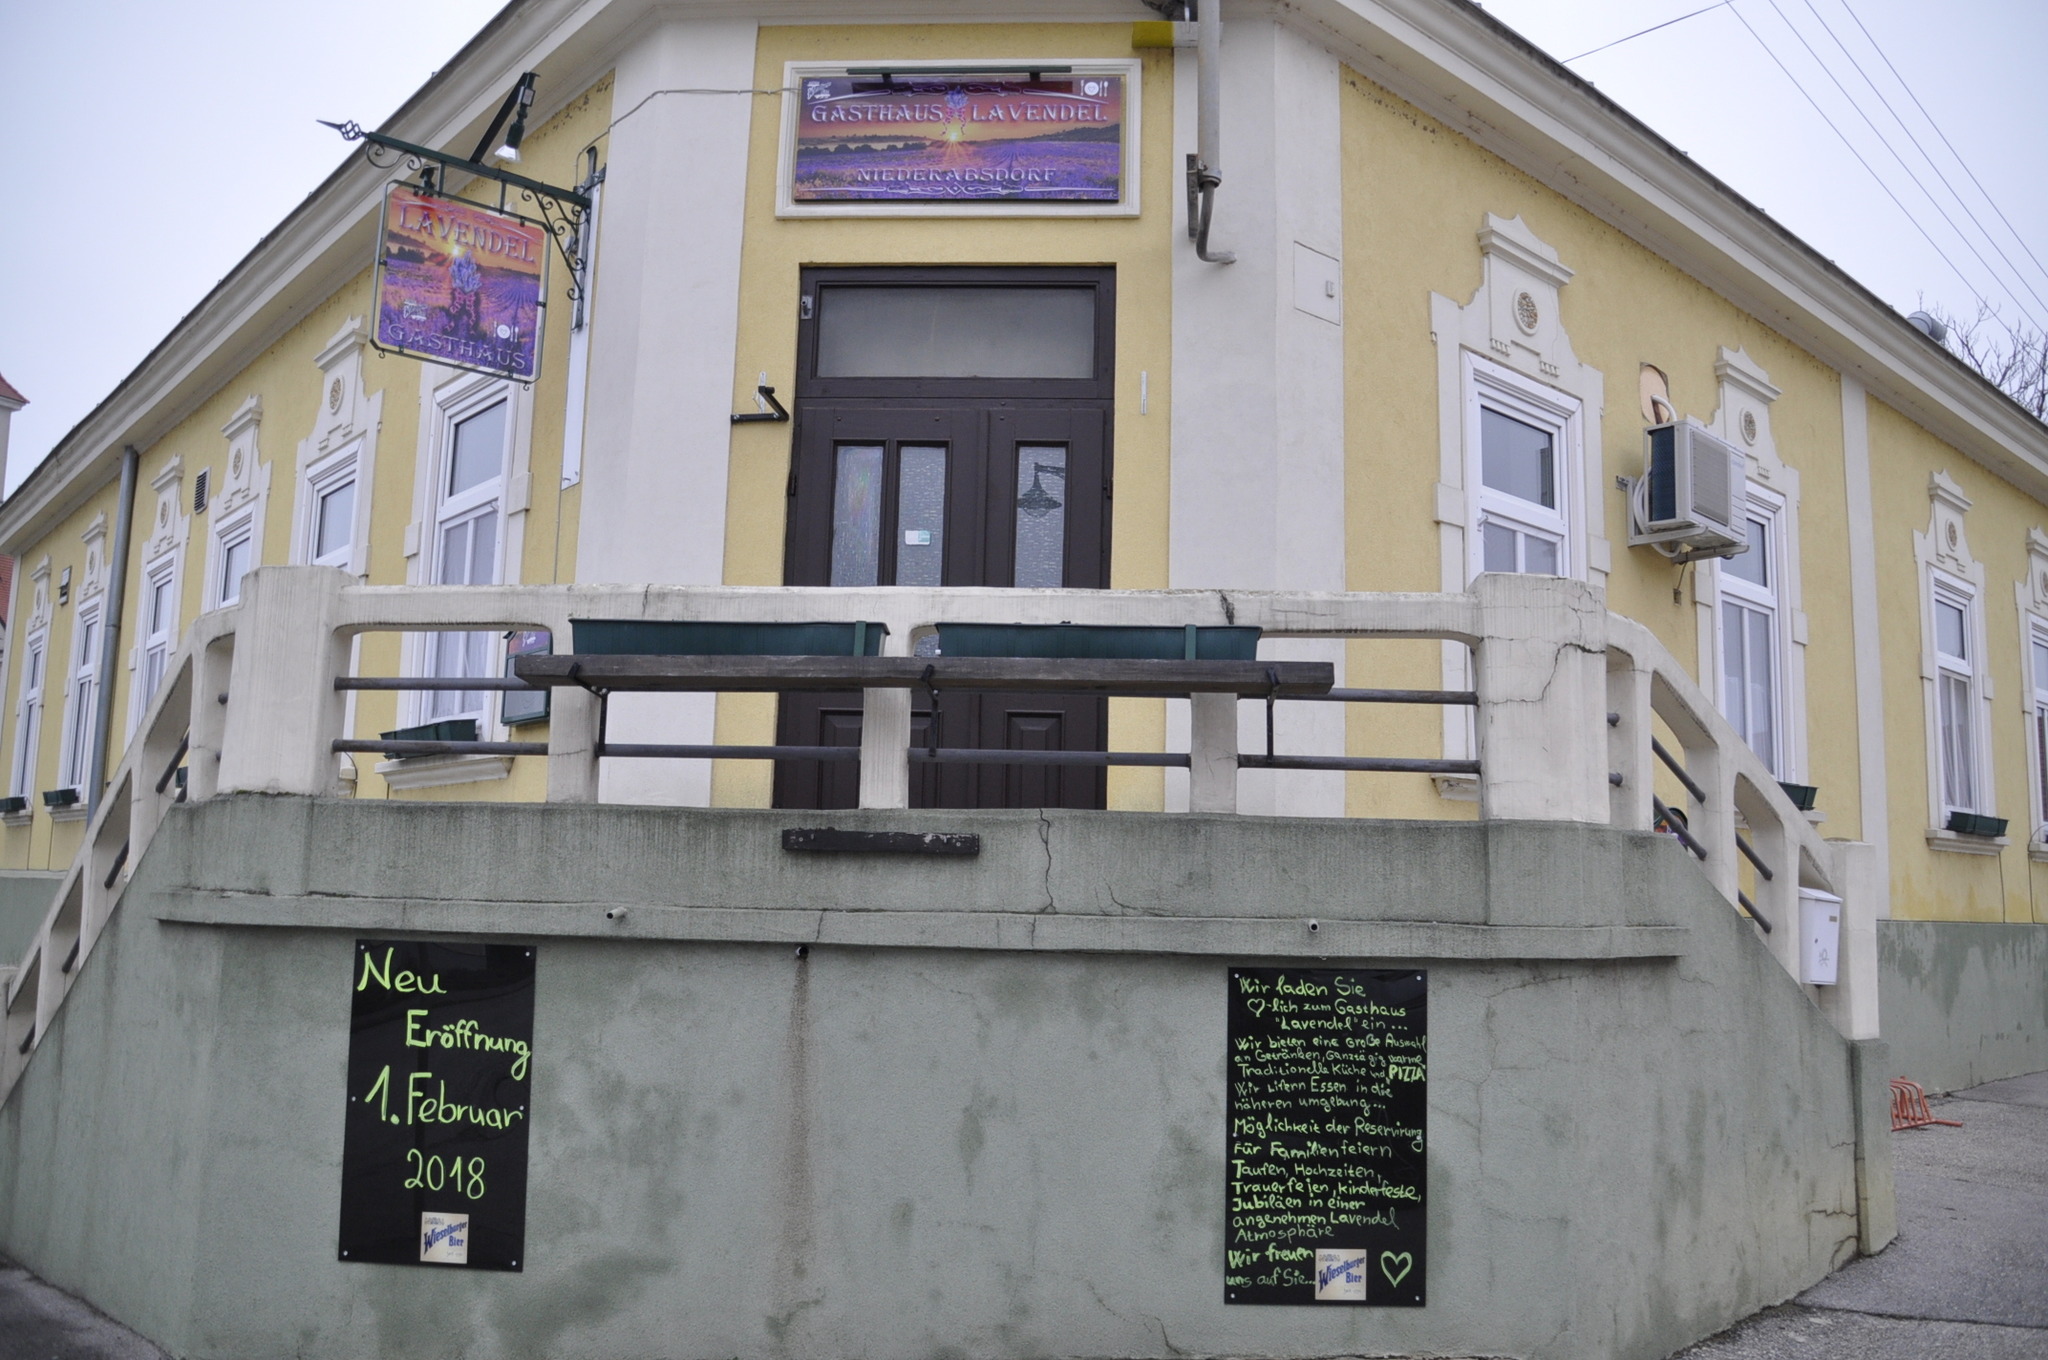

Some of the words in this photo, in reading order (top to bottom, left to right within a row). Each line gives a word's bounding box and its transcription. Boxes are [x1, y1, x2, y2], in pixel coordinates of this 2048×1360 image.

[811, 104, 944, 124] GASTHAUS
[972, 101, 1108, 123] LAVENDEL
[857, 167, 1057, 183] NIEDERABSDORF
[399, 206, 536, 264] LAVENDEL
[388, 323, 526, 369] GASTHAUS
[356, 946, 447, 994] Neu
[1239, 976, 1271, 994] Wir
[1276, 974, 1328, 996] laden
[1334, 976, 1366, 997] Sie
[1303, 1003, 1331, 1011] zum
[1334, 998, 1406, 1017] Gasthaus
[406, 1009, 532, 1081] Eröffnung
[1234, 1036, 1262, 1050] Wir
[1267, 1034, 1306, 1048] bieten
[1312, 1035, 1339, 1047] eine
[1385, 1032, 1427, 1053] Auswahl
[1237, 1060, 1329, 1078] Traditionelle
[1332, 1063, 1367, 1076] Küche
[1387, 1054, 1422, 1064] warme
[364, 1064, 400, 1125] 1.
[407, 1071, 523, 1130] Februar
[1234, 1081, 1260, 1097] Wir
[1311, 1076, 1346, 1092] Essen
[1357, 1079, 1368, 1094] in
[1371, 1082, 1393, 1098] die
[1234, 1097, 1292, 1110] näheren
[1234, 1112, 1321, 1138] Möglichkeit
[1325, 1117, 1351, 1134] der
[1354, 1116, 1423, 1152] Reservirung
[1234, 1142, 1262, 1155] Für
[404, 1148, 486, 1200] 2018
[1231, 1159, 1289, 1179] Taufen,
[1232, 1194, 1302, 1212] Jubiläen
[1308, 1192, 1323, 1207] in
[1327, 1196, 1366, 1210] einer
[1232, 1211, 1327, 1229] angenehmen
[1330, 1206, 1400, 1230] Lavendel
[448, 1235, 464, 1247] Bier
[1234, 1223, 1335, 1244] Atmosphäre
[1228, 1248, 1261, 1269] Wir
[1265, 1242, 1314, 1262] freuen
[1226, 1275, 1253, 1288] uns
[1256, 1266, 1281, 1286] auf
[1345, 1271, 1362, 1283] Bier
